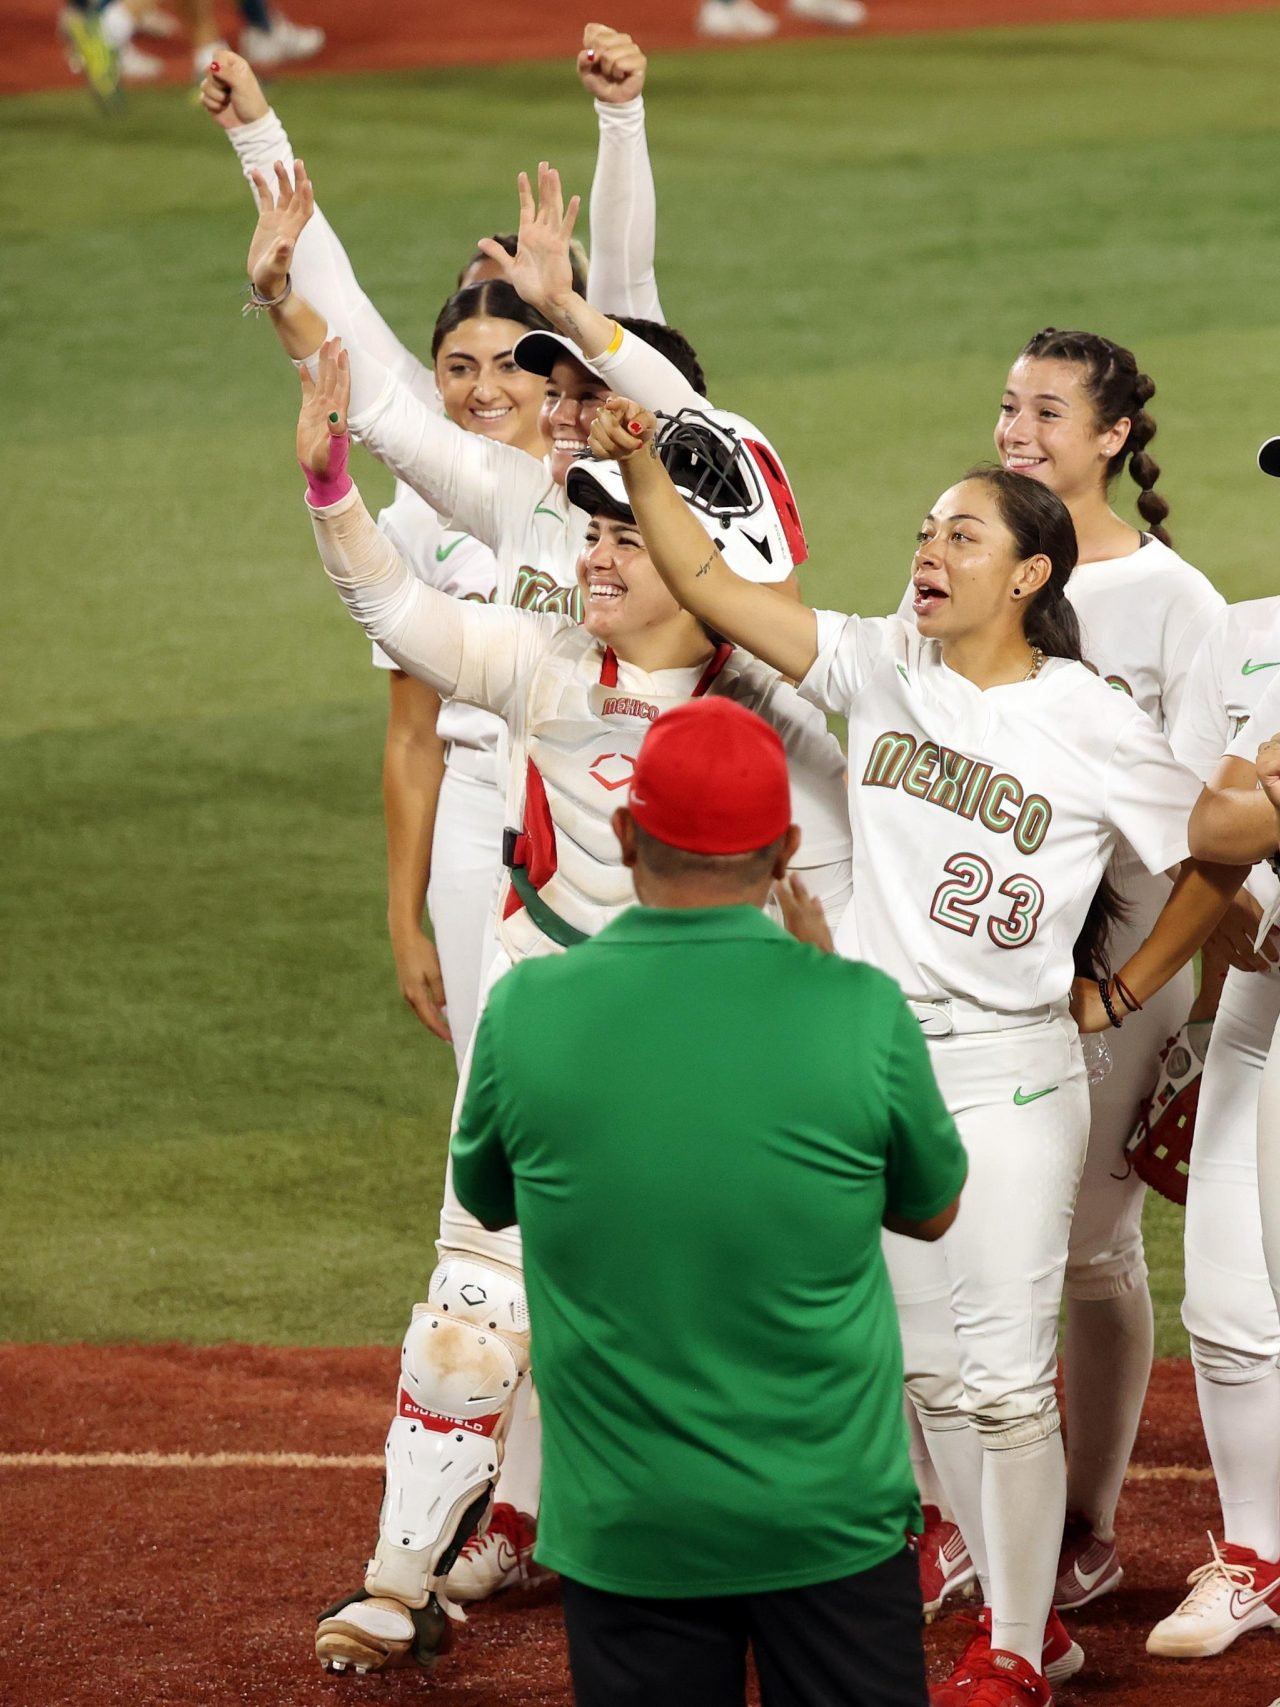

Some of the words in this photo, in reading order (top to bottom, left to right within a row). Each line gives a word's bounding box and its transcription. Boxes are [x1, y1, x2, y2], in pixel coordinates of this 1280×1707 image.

[601, 697, 660, 722] MEXICO
[861, 731, 1053, 856] MEXICO
[929, 851, 1045, 950] 23
[993, 1654, 1018, 1671] NIKE
